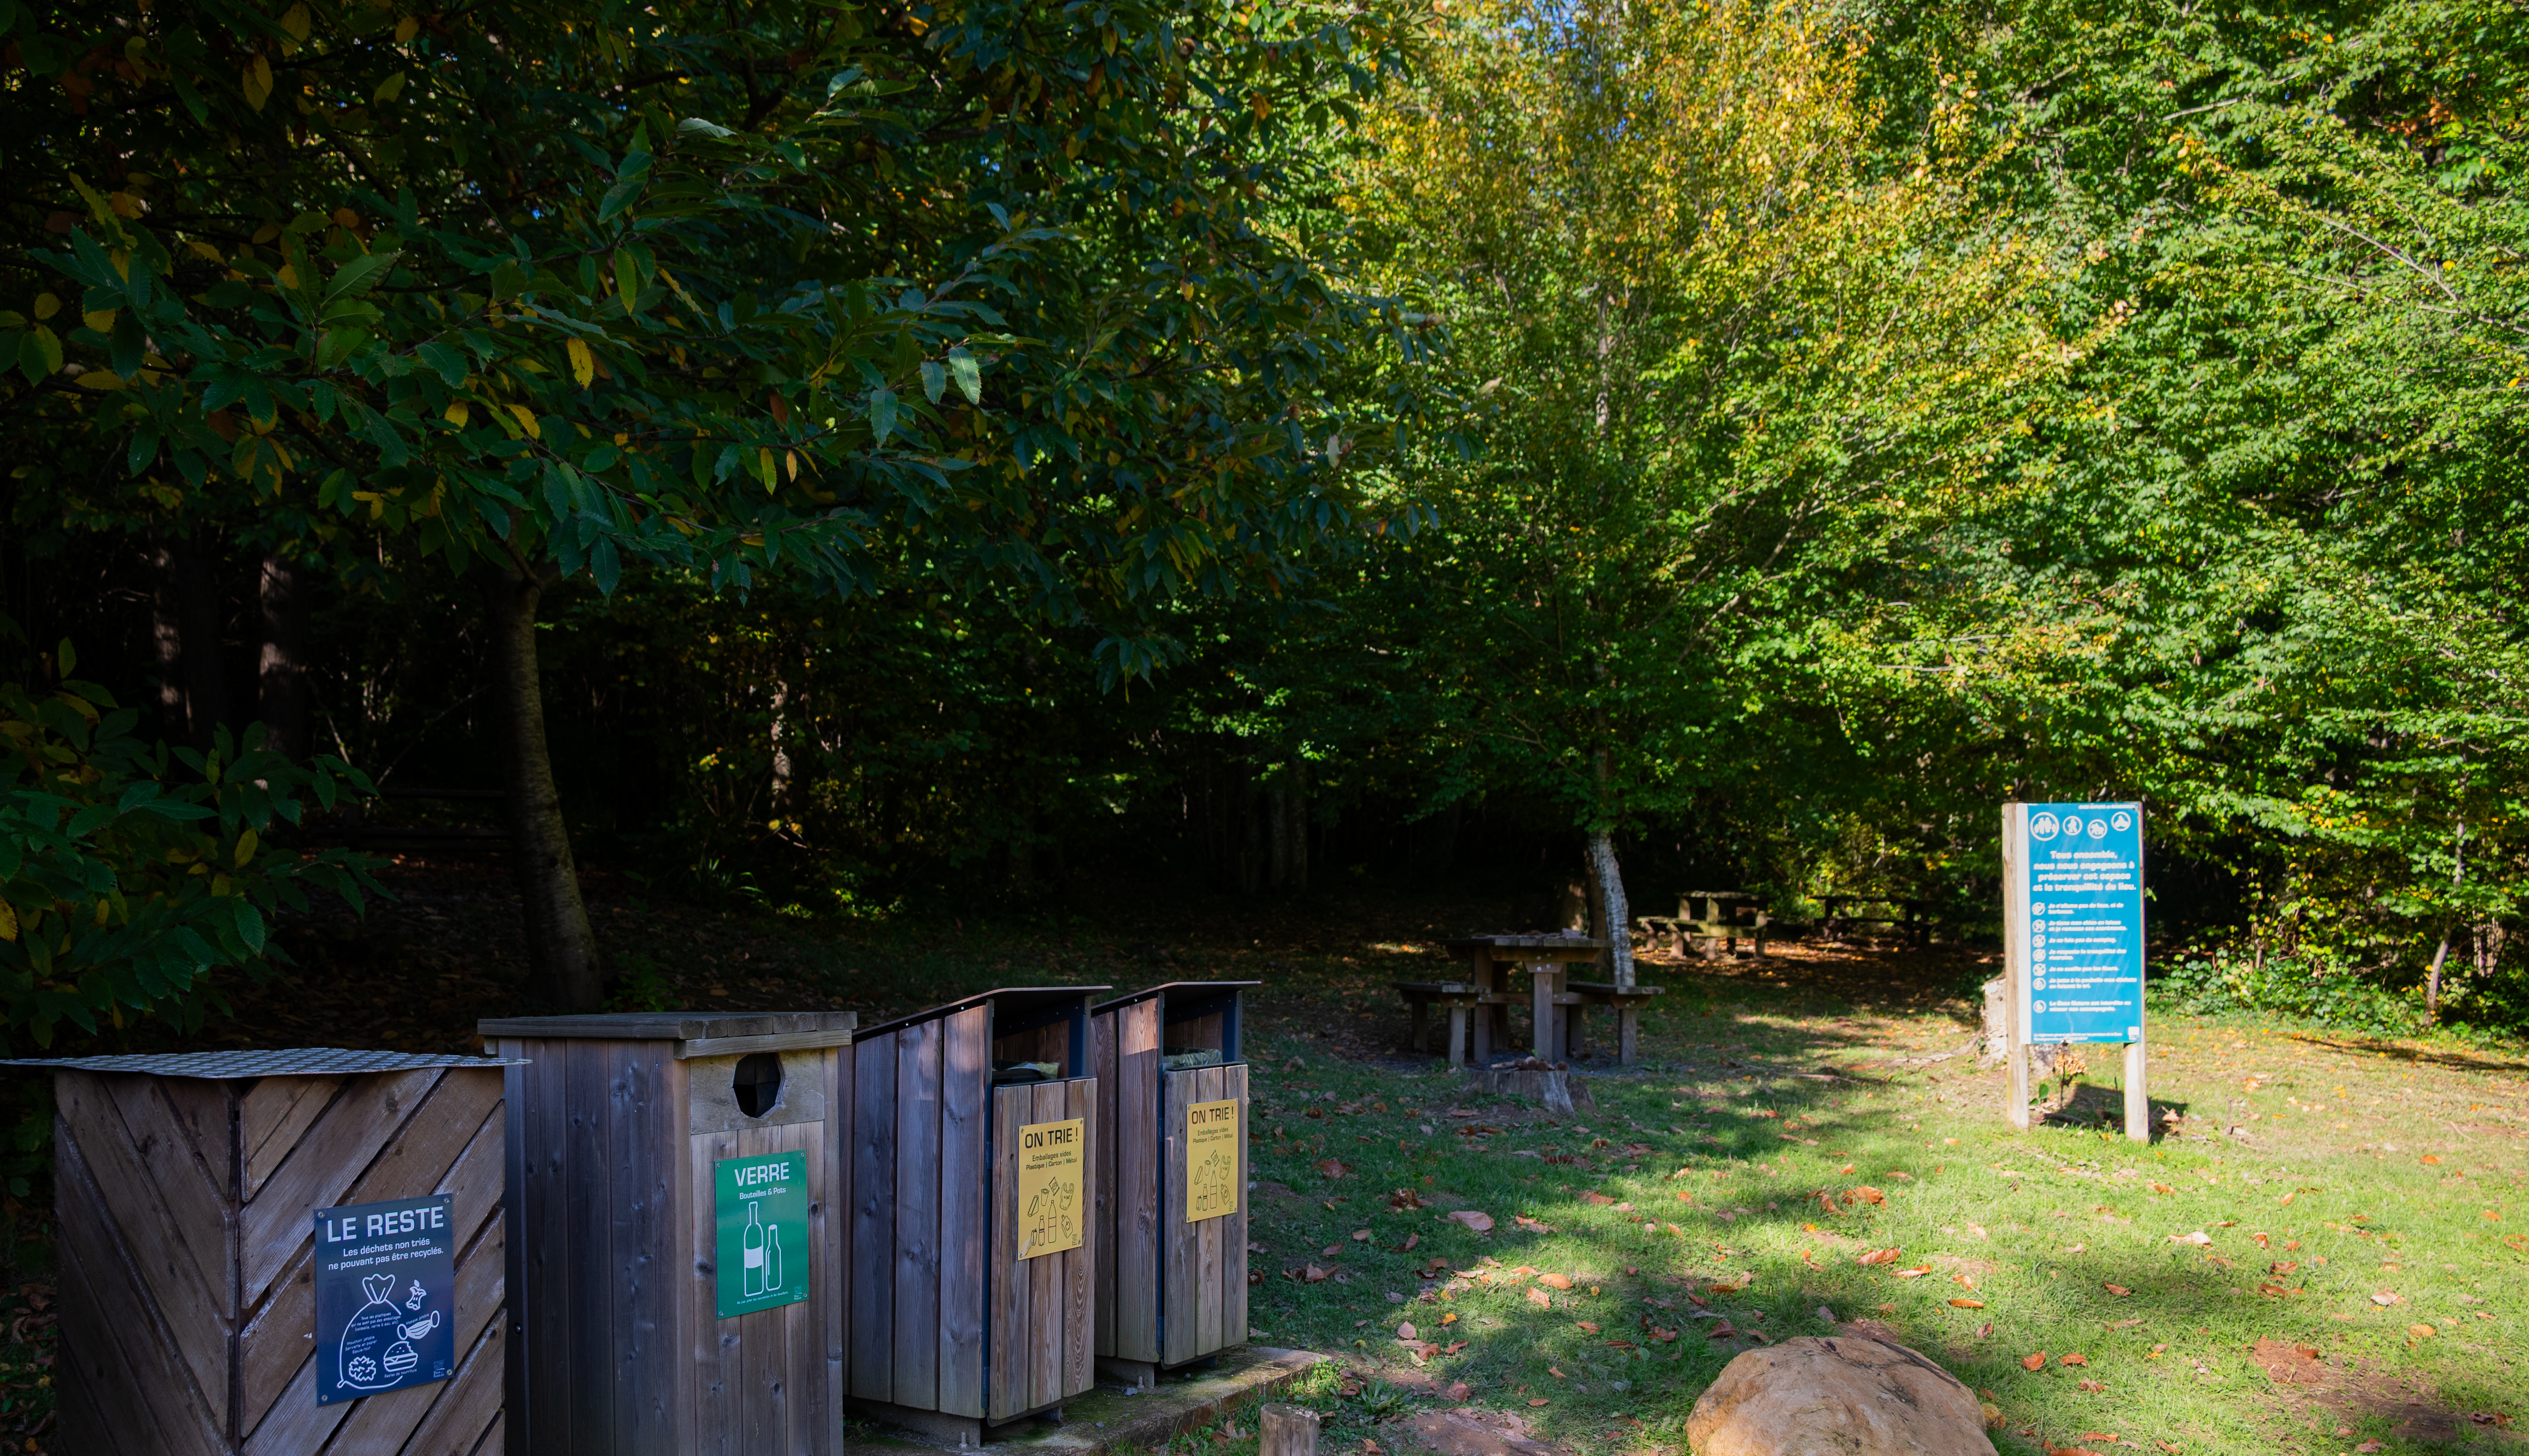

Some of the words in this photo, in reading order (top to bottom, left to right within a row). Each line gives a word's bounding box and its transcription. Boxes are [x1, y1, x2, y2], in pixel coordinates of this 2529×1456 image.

[2050, 851, 2072, 859] Tous
[2073, 850, 2117, 859] ensemble,
[2080, 862, 2127, 871] engageons
[2038, 873, 2081, 882] préserver
[2054, 883, 2103, 892] tranquillité
[1192, 1110, 1206, 1124] ON
[1209, 1107, 1229, 1122] TRIE
[1025, 1131, 1043, 1148] ON
[1048, 1128, 1073, 1146] TRIE
[1032, 1153, 1058, 1162] Emballages
[734, 1162, 789, 1186] VERRE
[739, 1190, 766, 1200] Bouteilles
[328, 1217, 357, 1242] LE
[367, 1206, 444, 1237] RESTE
[343, 1247, 358, 1257] Les
[360, 1243, 393, 1255] déchets
[412, 1238, 430, 1247] triés
[341, 1257, 374, 1270] pouvant
[375, 1255, 390, 1265] pas
[392, 1252, 408, 1261] être
[411, 1247, 444, 1258] recyclés.
